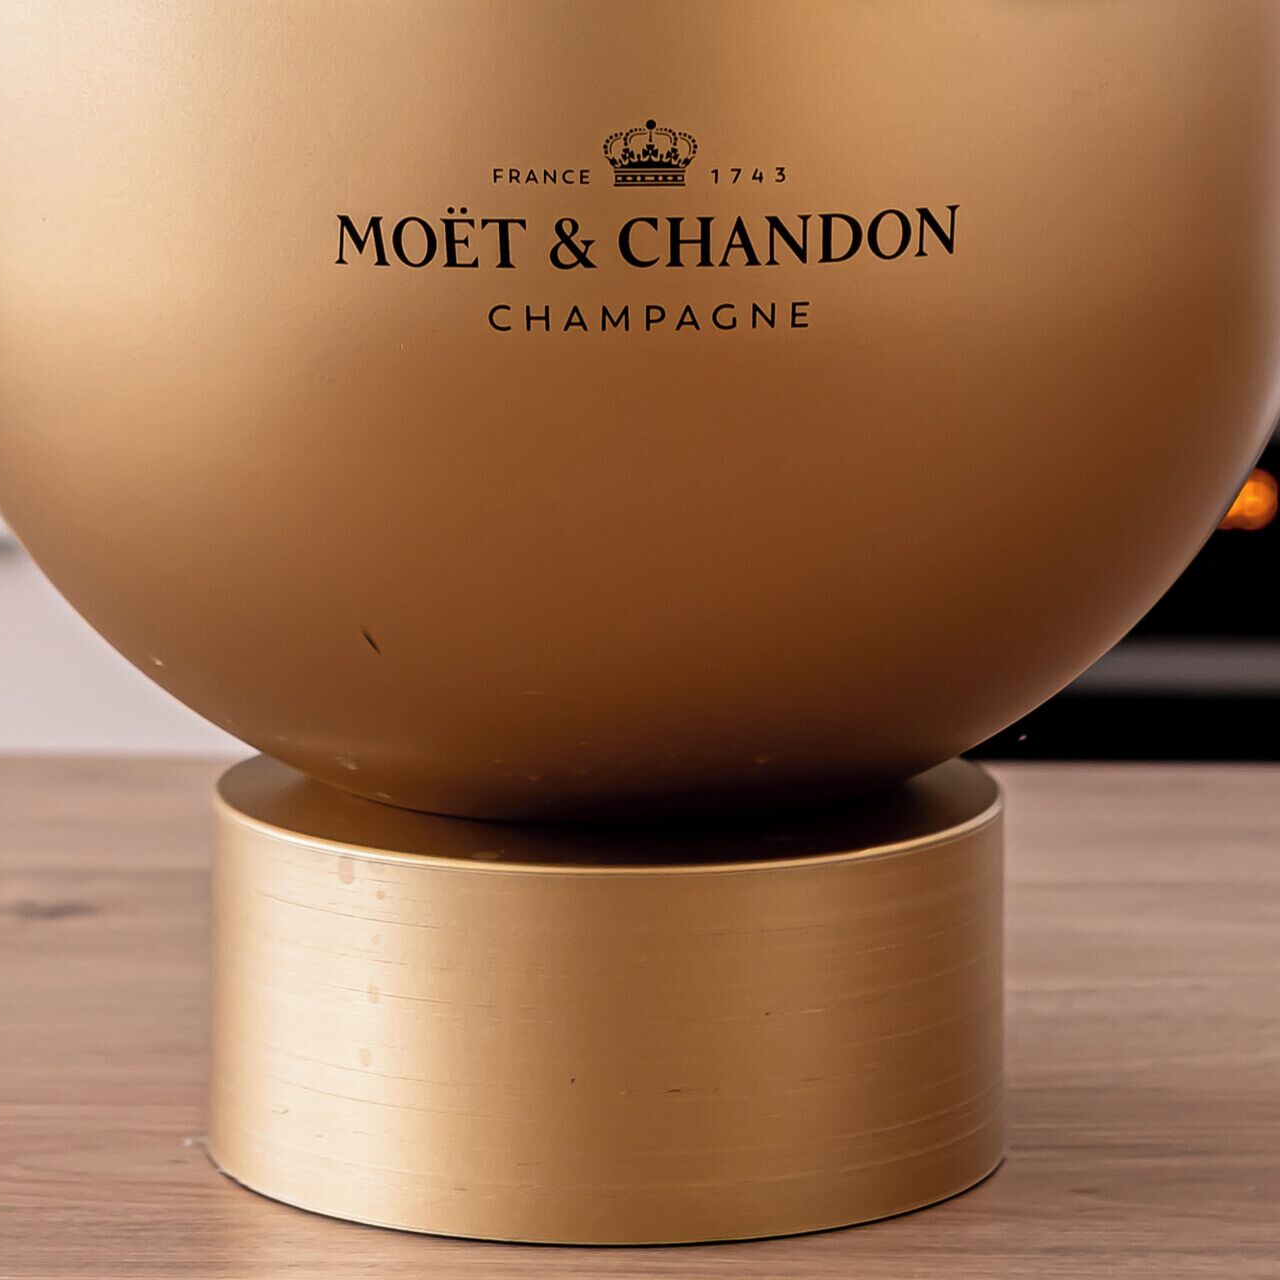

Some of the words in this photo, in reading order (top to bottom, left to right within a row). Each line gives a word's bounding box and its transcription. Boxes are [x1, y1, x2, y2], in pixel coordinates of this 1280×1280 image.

[492, 167, 591, 186] FRANCE
[710, 166, 787, 186] 1743
[334, 206, 528, 269] MOËT
[549, 217, 599, 270] &
[618, 204, 962, 269] CHANDON
[487, 301, 811, 332] CHAMPAGNE
